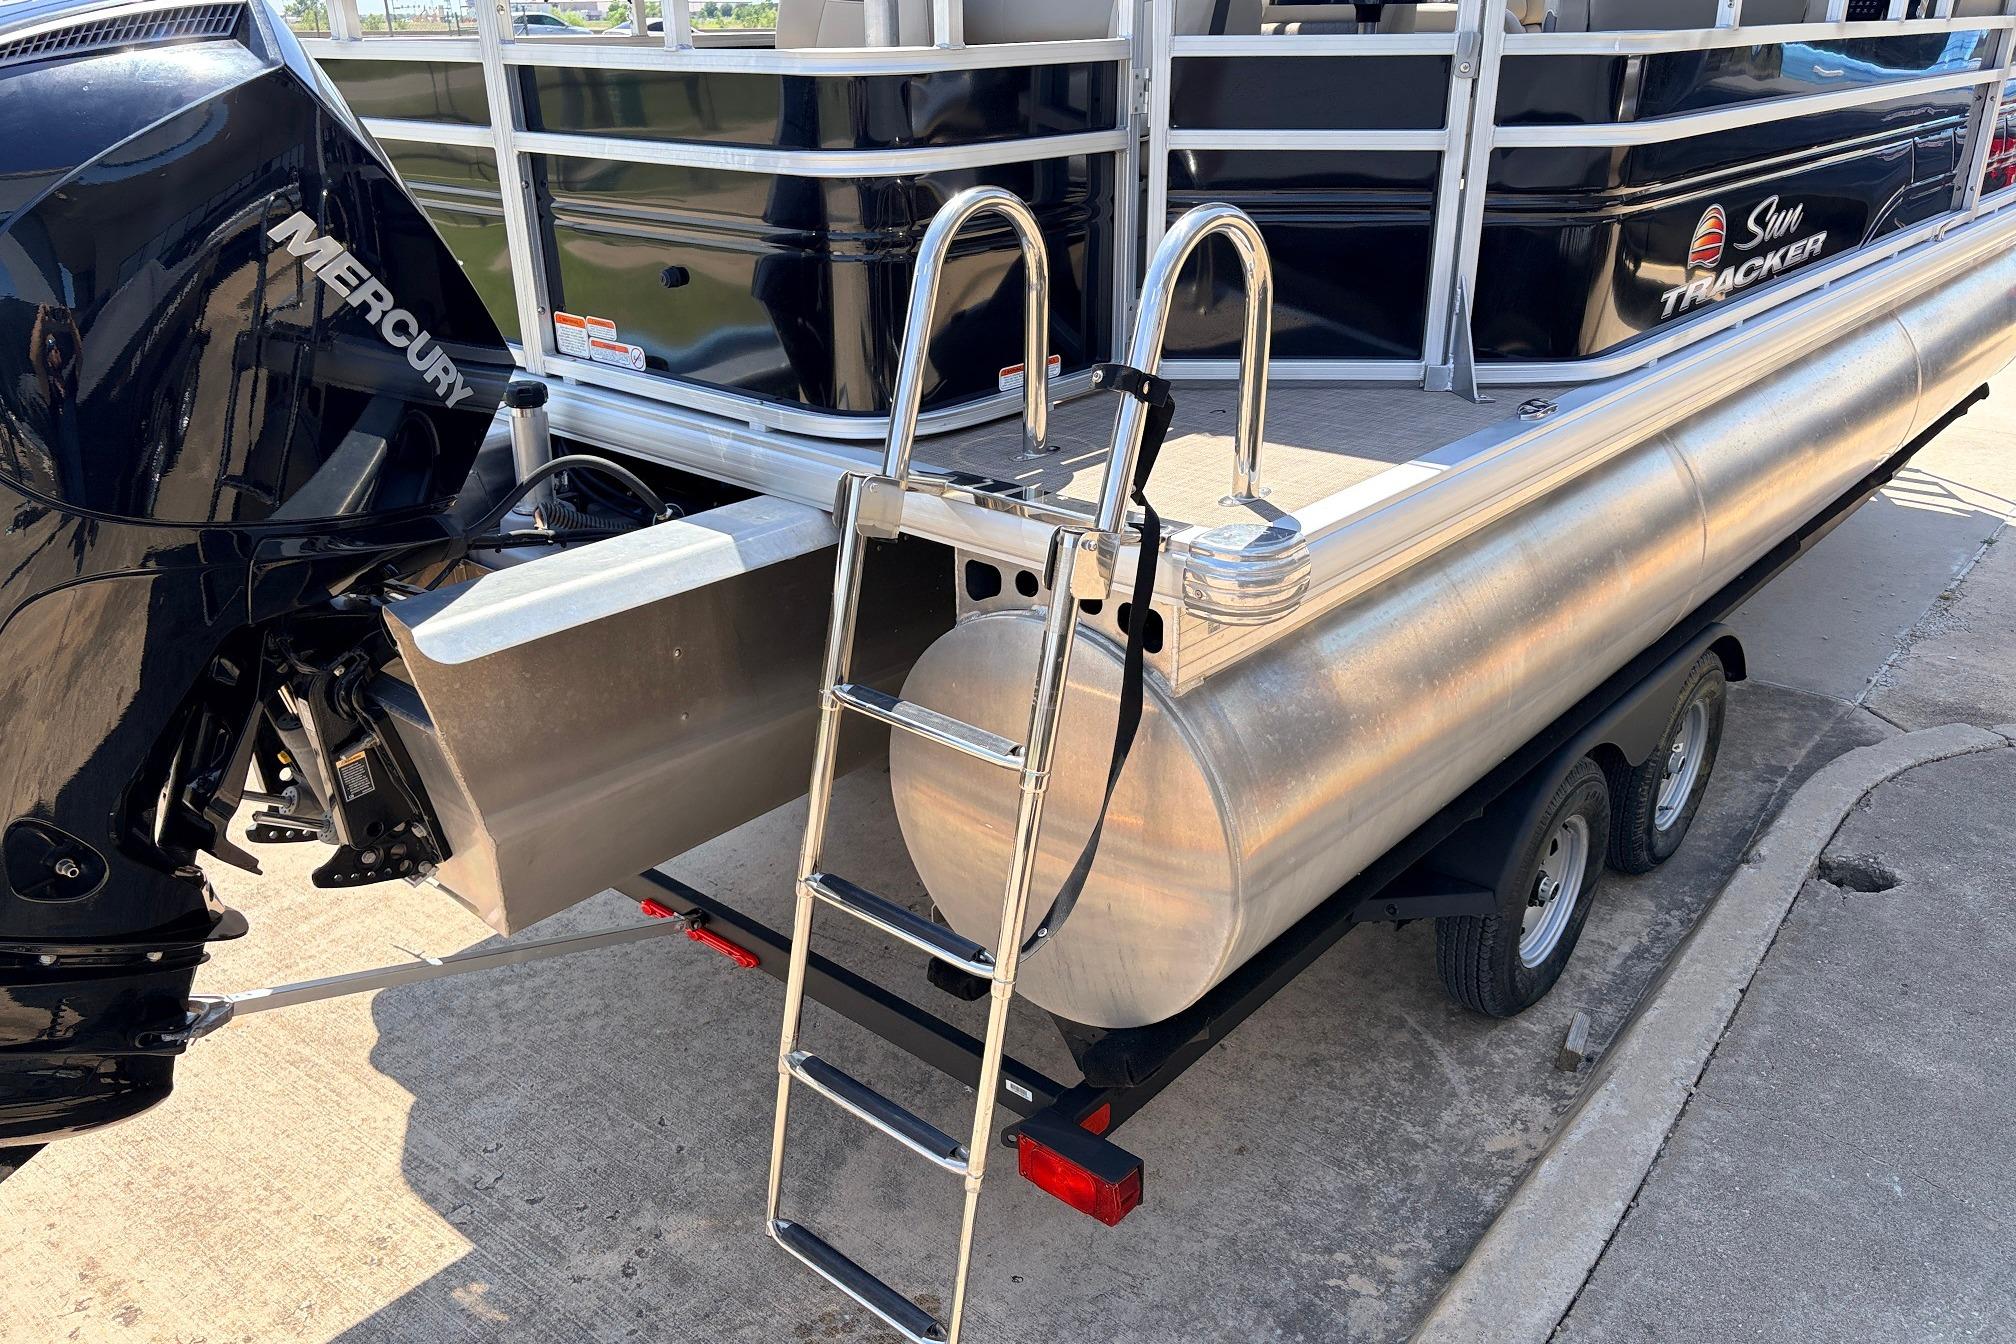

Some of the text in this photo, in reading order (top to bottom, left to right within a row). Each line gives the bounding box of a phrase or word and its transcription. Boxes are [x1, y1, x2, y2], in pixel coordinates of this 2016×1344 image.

[1733, 194, 1803, 250] Sun
[267, 210, 474, 409] MERCURY
[1660, 230, 1828, 319] TRACKER
